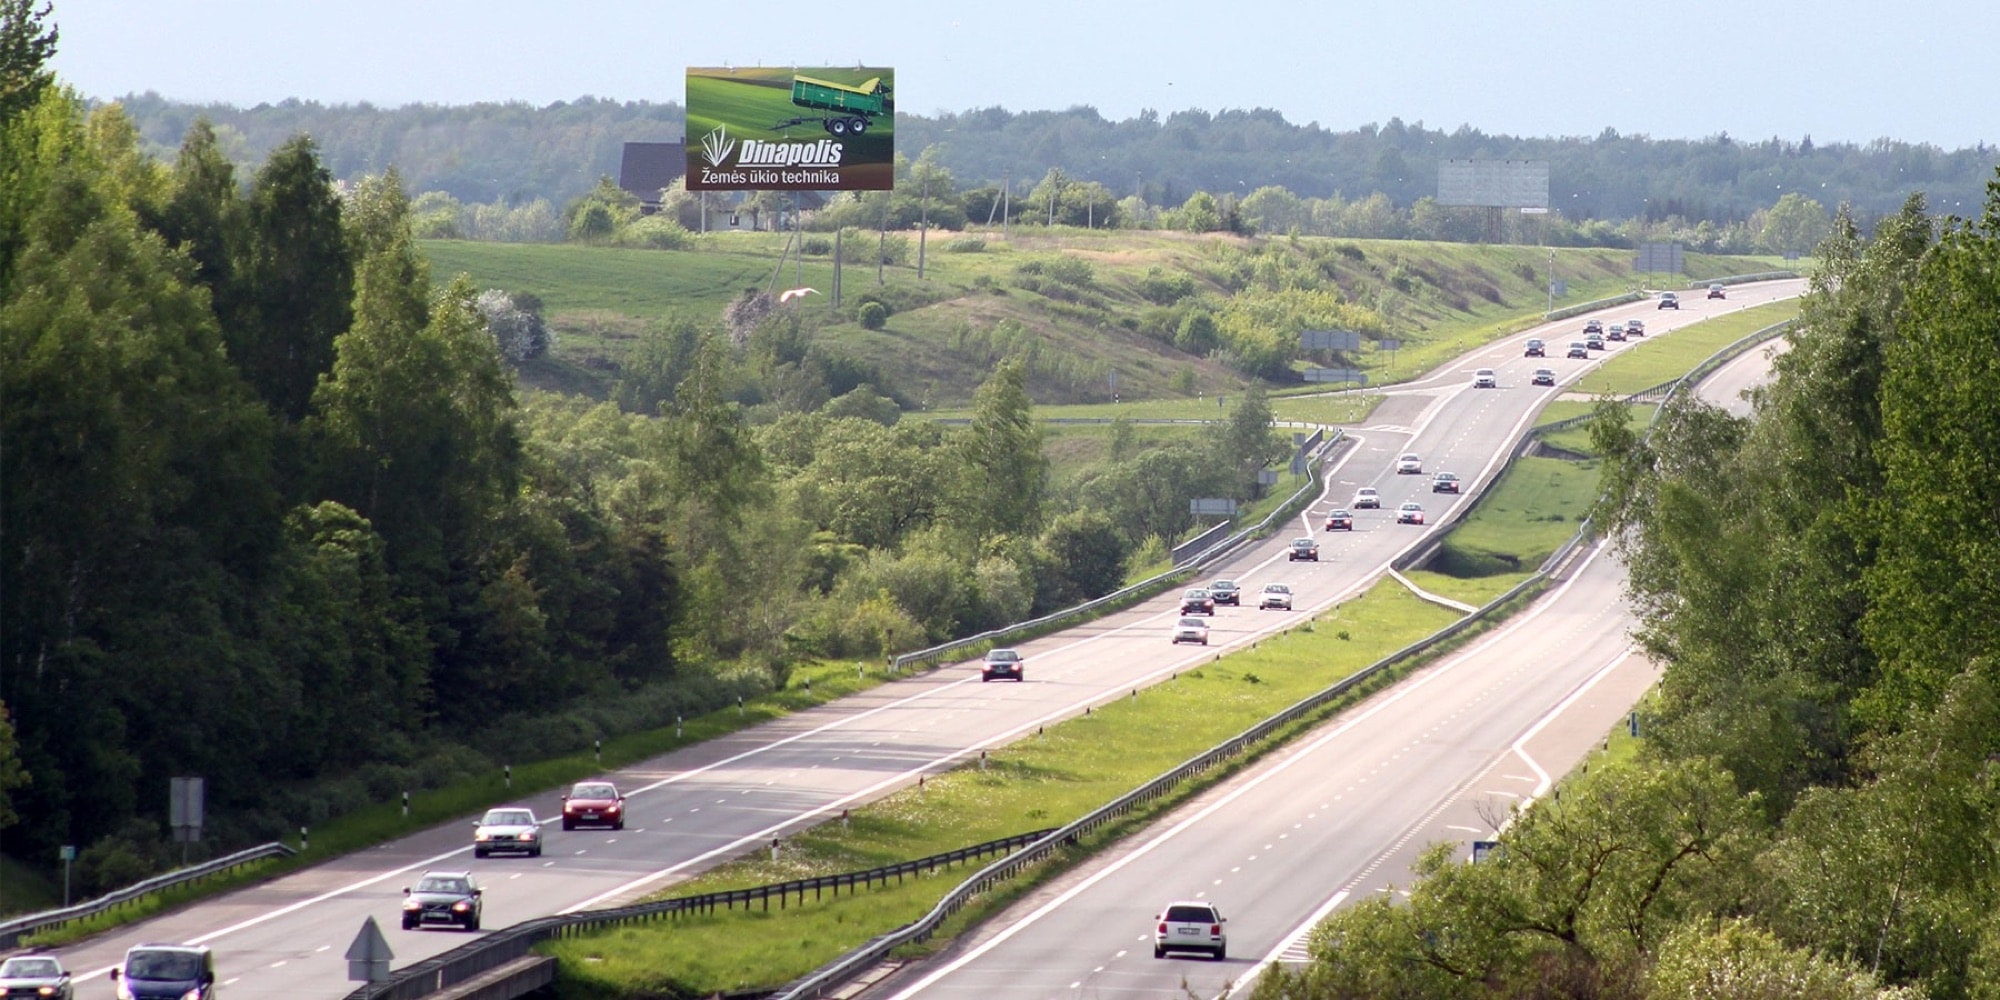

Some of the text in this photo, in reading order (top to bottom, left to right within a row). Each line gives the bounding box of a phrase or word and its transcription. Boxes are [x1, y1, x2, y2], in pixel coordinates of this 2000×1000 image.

[739, 139, 842, 166] Dinapolis
[701, 167, 839, 184] Žemės ūkio technika
